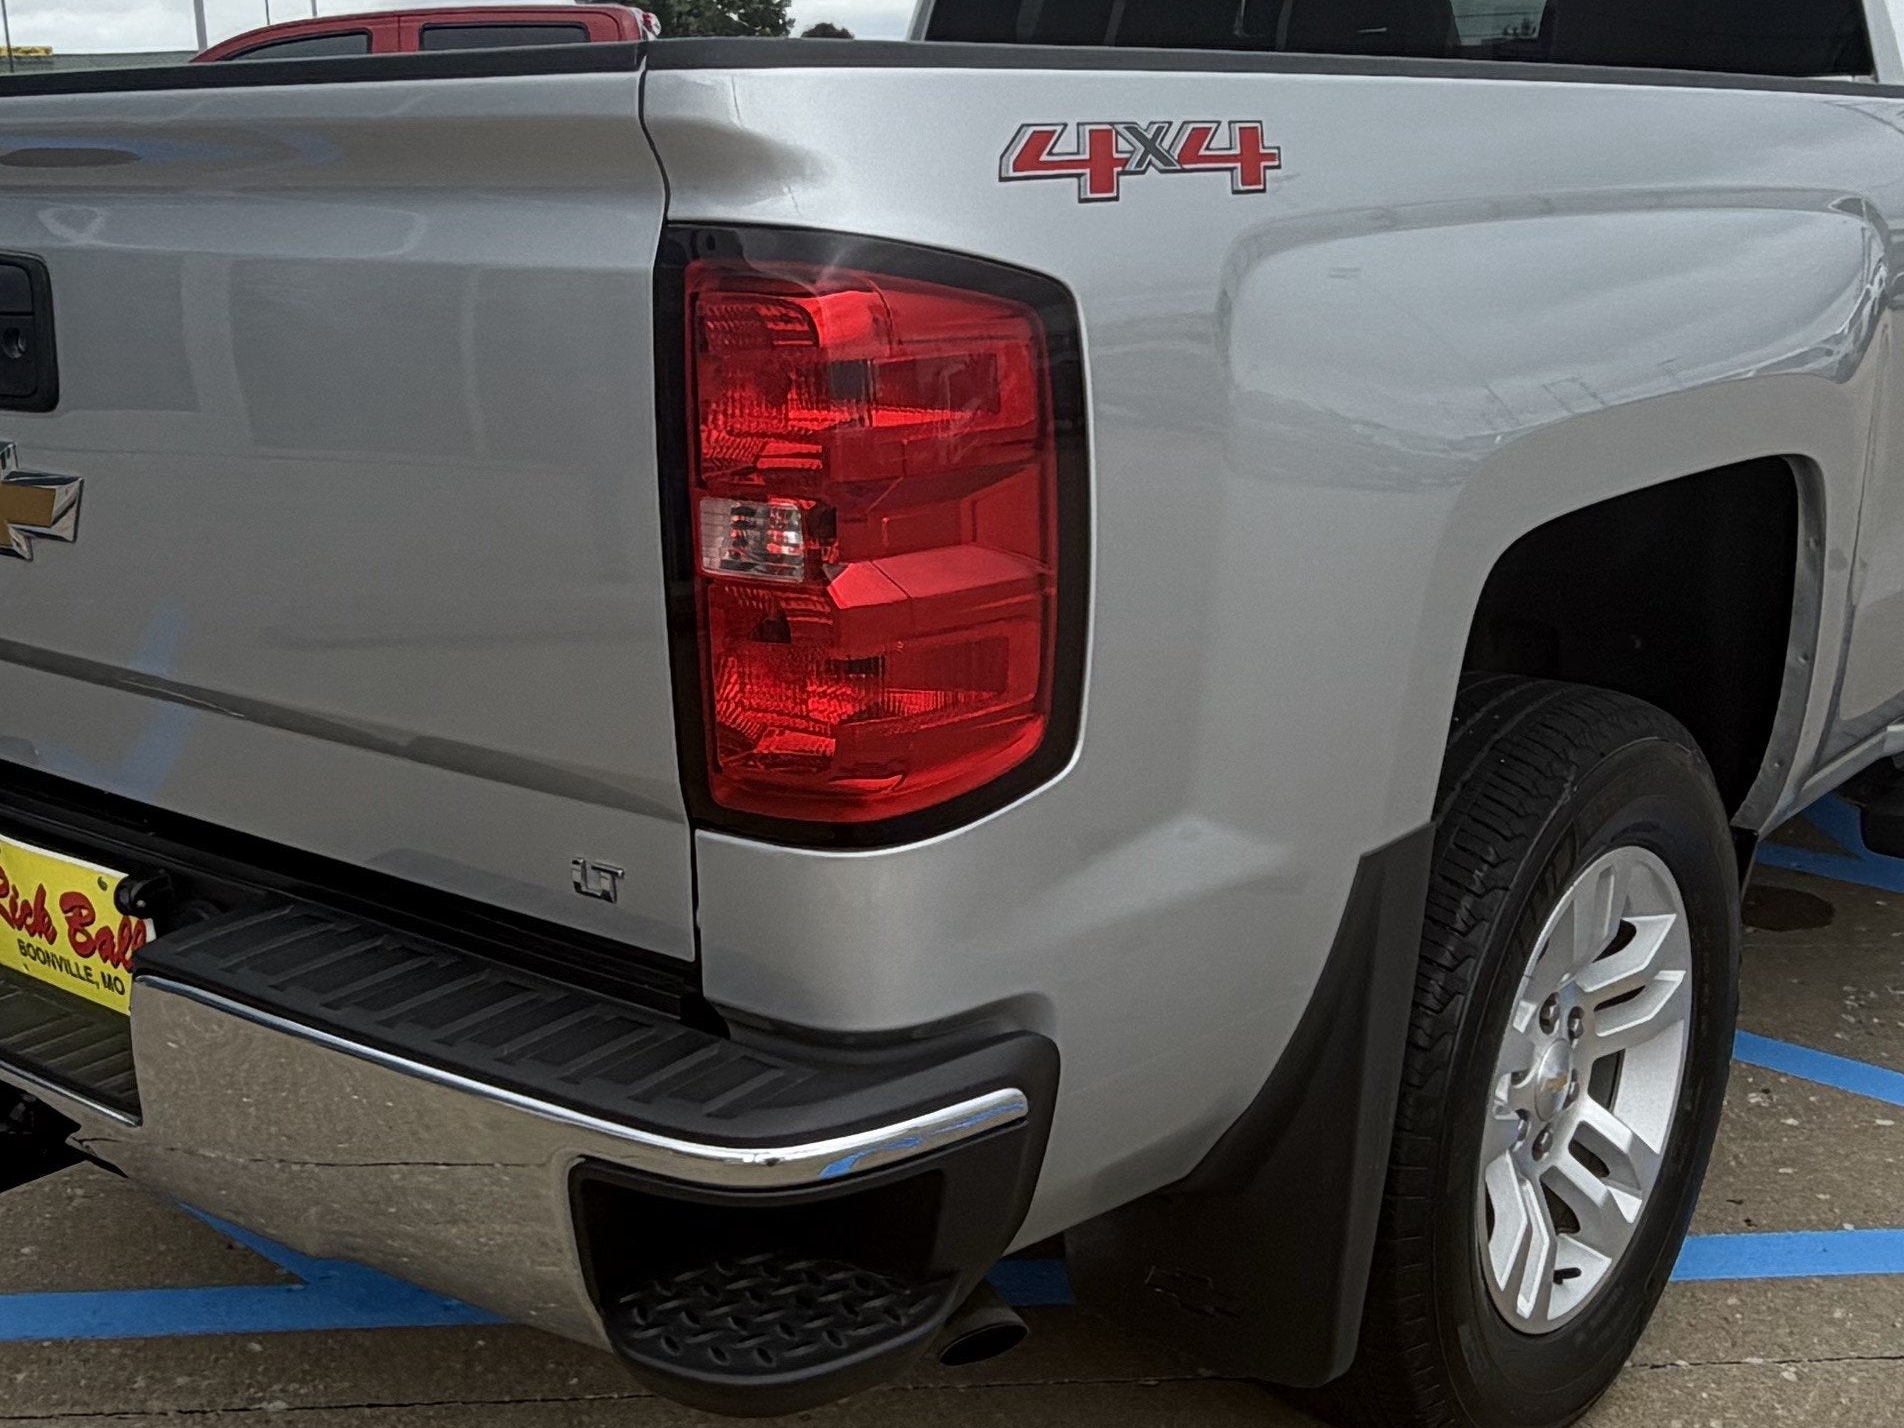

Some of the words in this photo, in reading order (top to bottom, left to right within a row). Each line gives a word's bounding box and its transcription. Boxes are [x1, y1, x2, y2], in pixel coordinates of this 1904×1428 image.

[571, 857, 625, 904] LT
[59, 891, 148, 974] Ball
[17, 937, 100, 990] BOONVILLE,
[100, 971, 126, 996] MO
